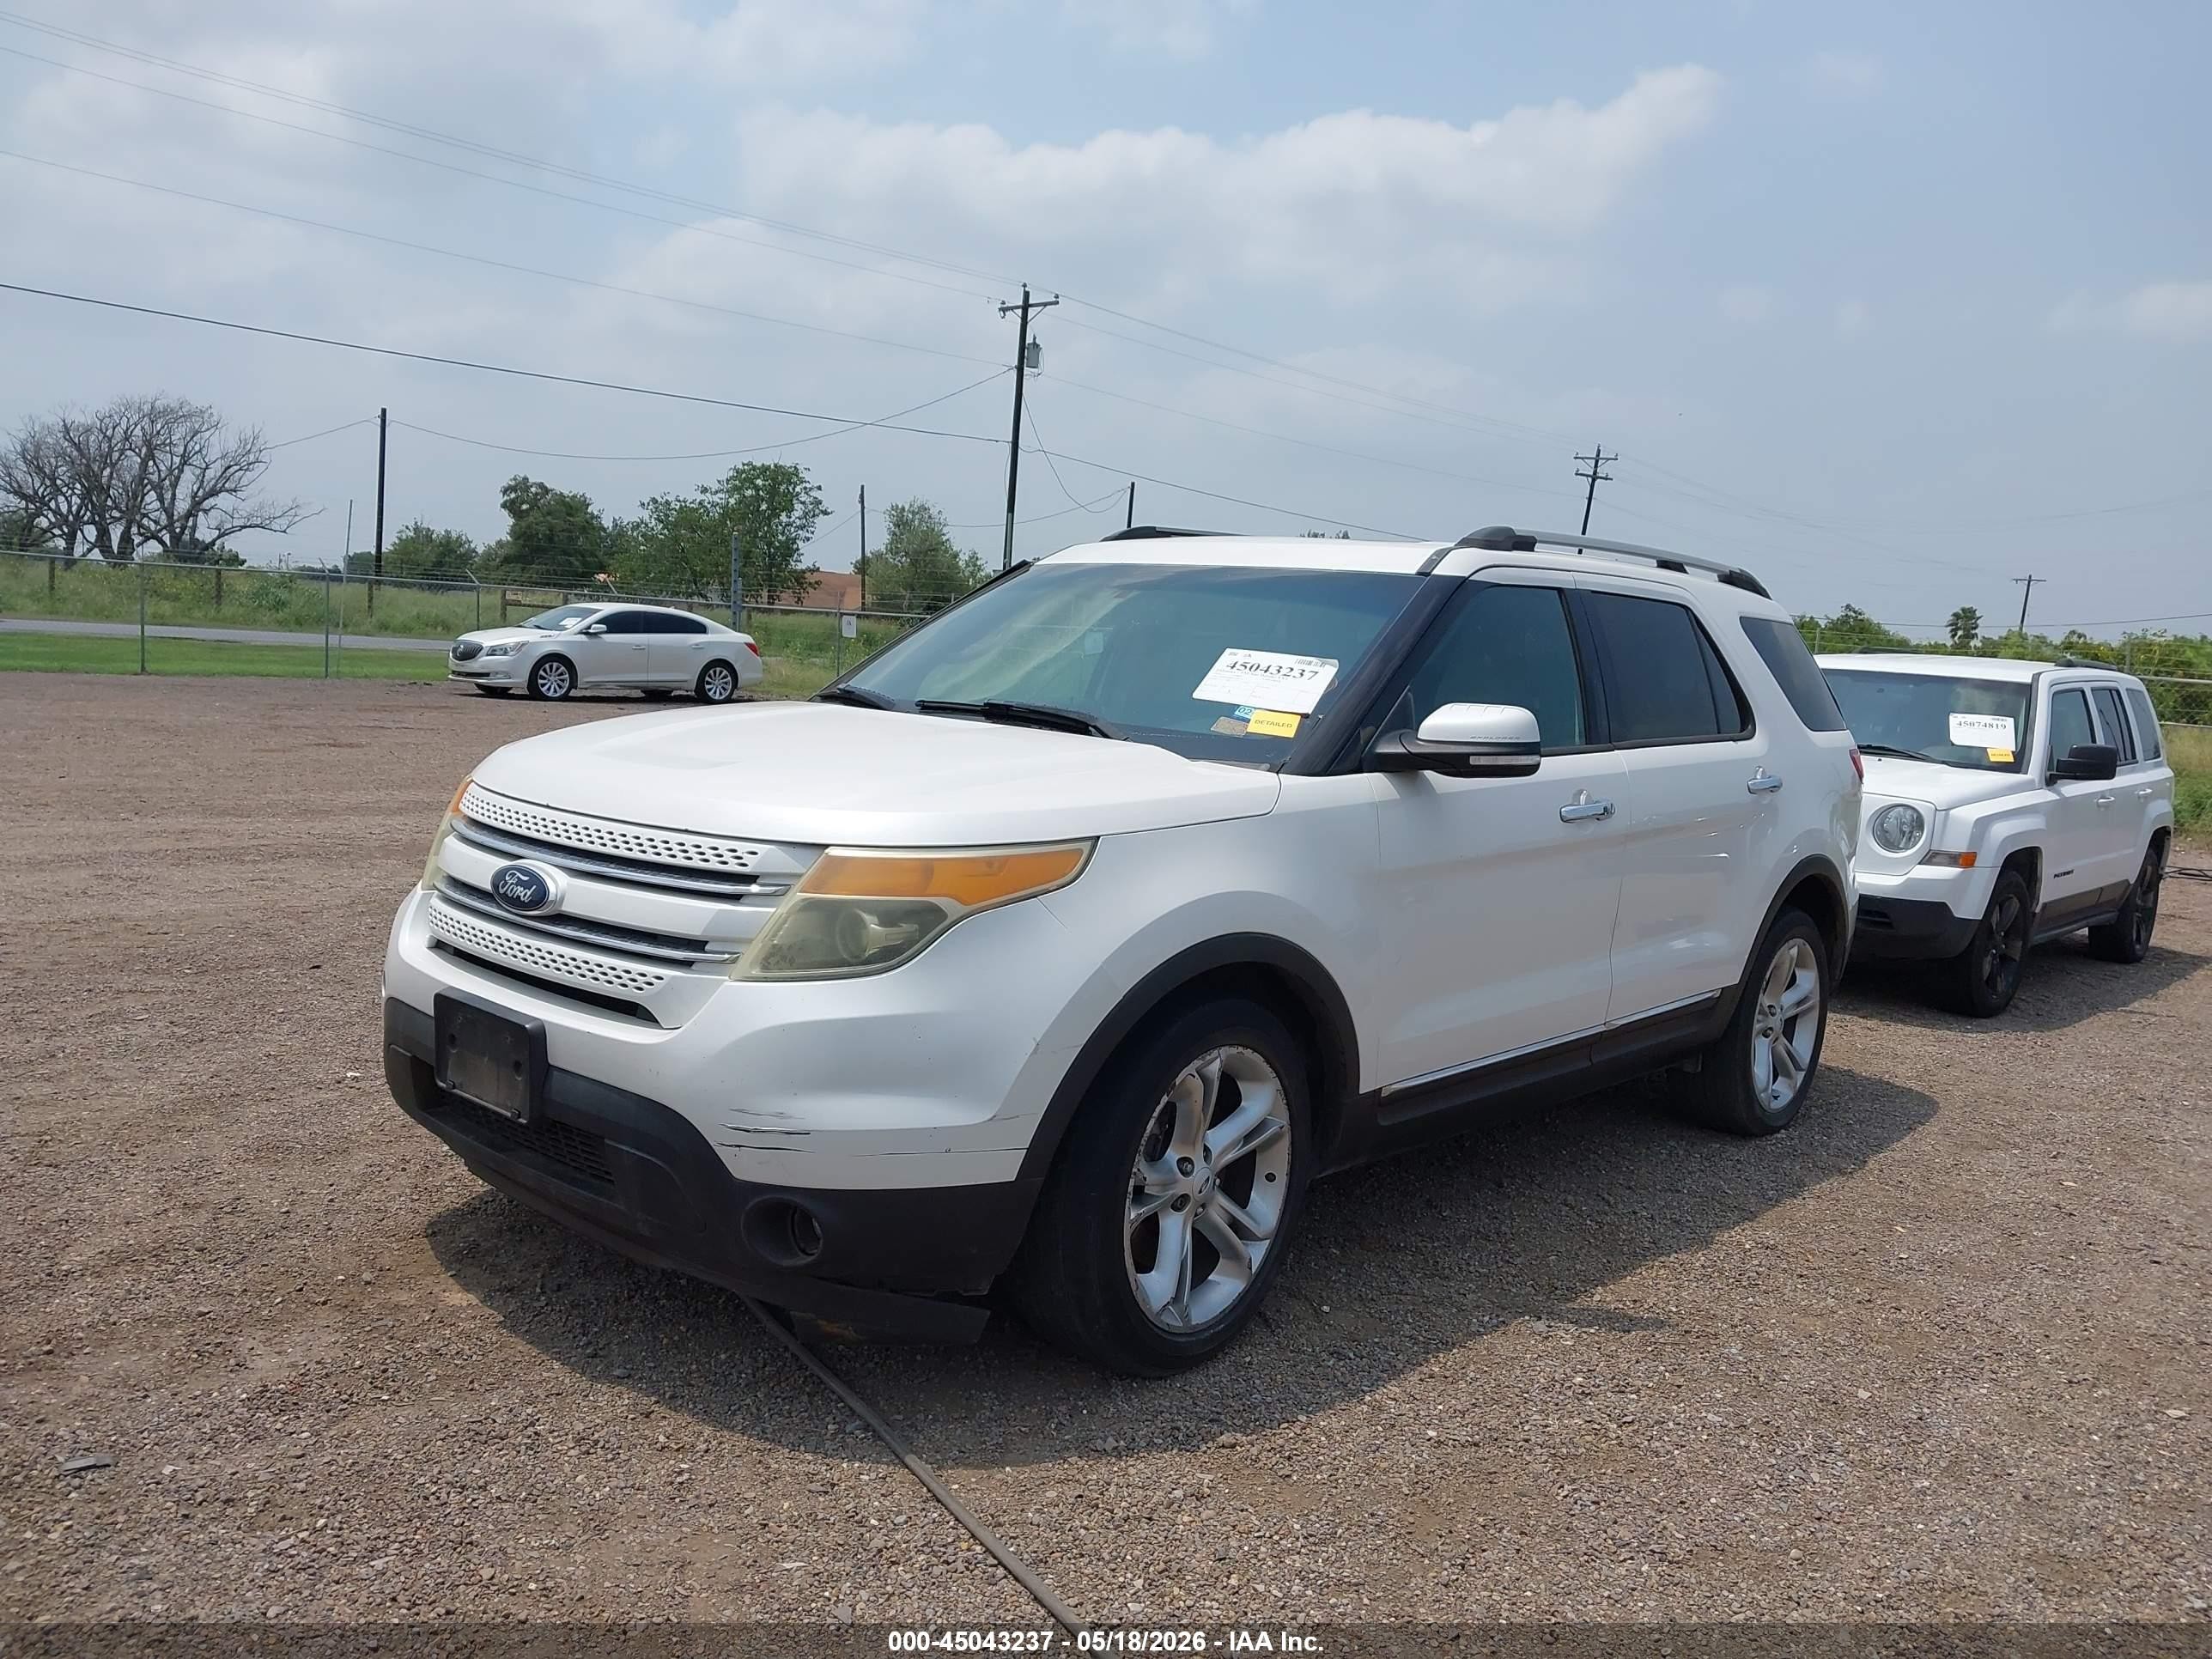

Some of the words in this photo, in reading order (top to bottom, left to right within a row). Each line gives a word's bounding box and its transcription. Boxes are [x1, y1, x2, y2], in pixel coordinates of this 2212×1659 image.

[1225, 660, 1319, 681] 45043237
[1254, 719, 1293, 728] DETAILED
[1956, 720, 2007, 730] 45074819
[498, 870, 537, 903] Ford
